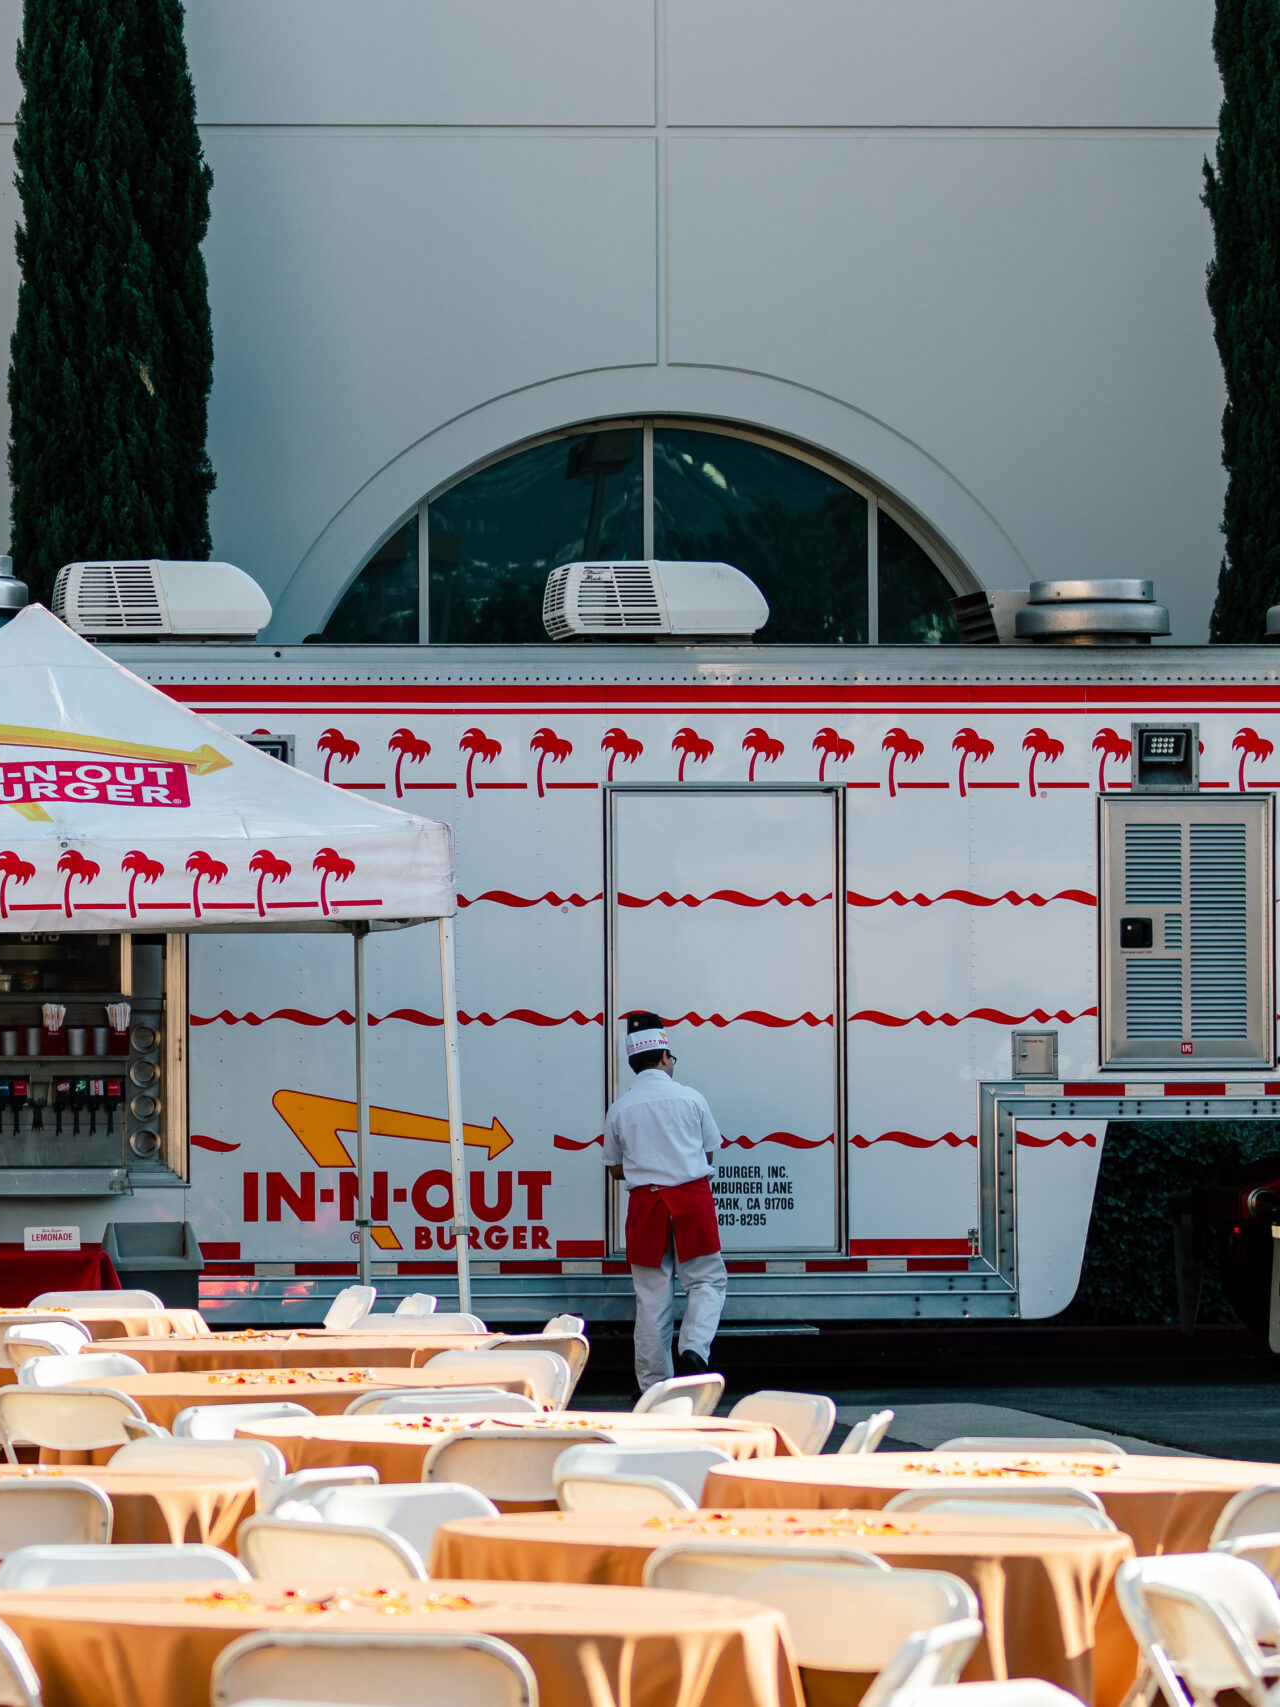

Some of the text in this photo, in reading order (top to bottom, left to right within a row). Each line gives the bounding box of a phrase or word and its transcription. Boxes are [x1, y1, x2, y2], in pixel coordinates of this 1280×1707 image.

[718, 1166, 789, 1180] BURGER, INC.
[767, 1181, 793, 1194] LANE
[243, 1169, 552, 1223] IN-N-OUT
[714, 1197, 795, 1212] PARK, CA 91706
[718, 1213, 767, 1226] 813-8295
[31, 1232, 72, 1241] LEMONADE
[414, 1225, 553, 1251] BURGER
